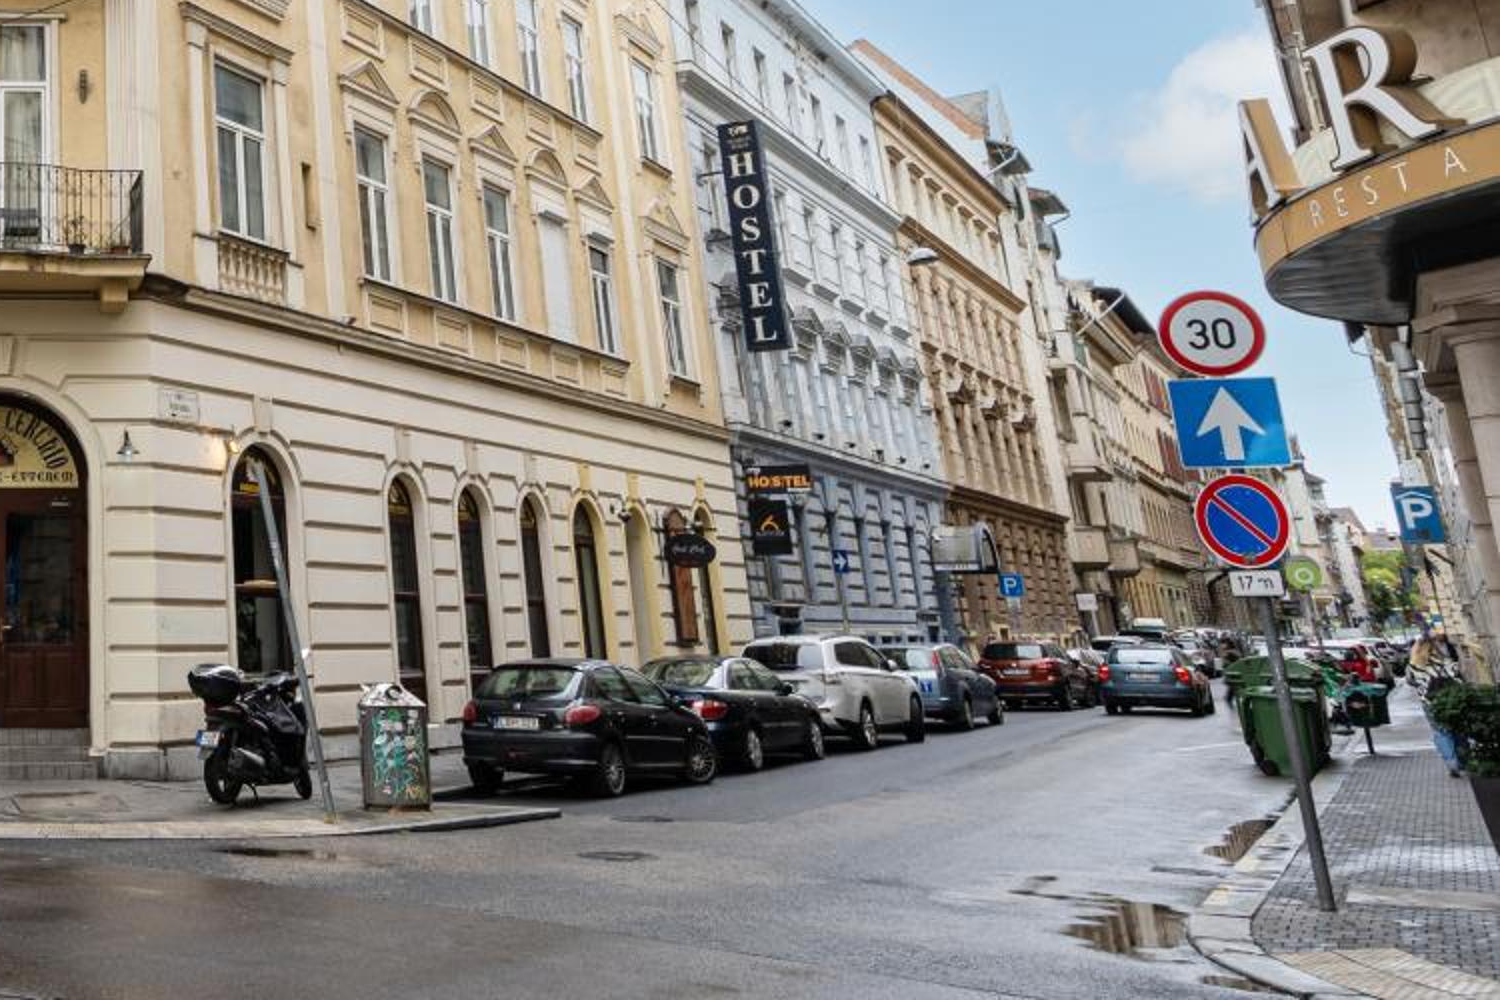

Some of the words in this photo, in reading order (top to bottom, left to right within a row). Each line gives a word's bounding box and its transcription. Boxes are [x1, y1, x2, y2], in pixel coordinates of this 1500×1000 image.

[728, 151, 777, 343] HOSTEL
[1187, 318, 1236, 350] 30
[747, 475, 810, 488] HOSTEL
[1401, 498, 1433, 529] P
[1003, 577, 1017, 594] P
